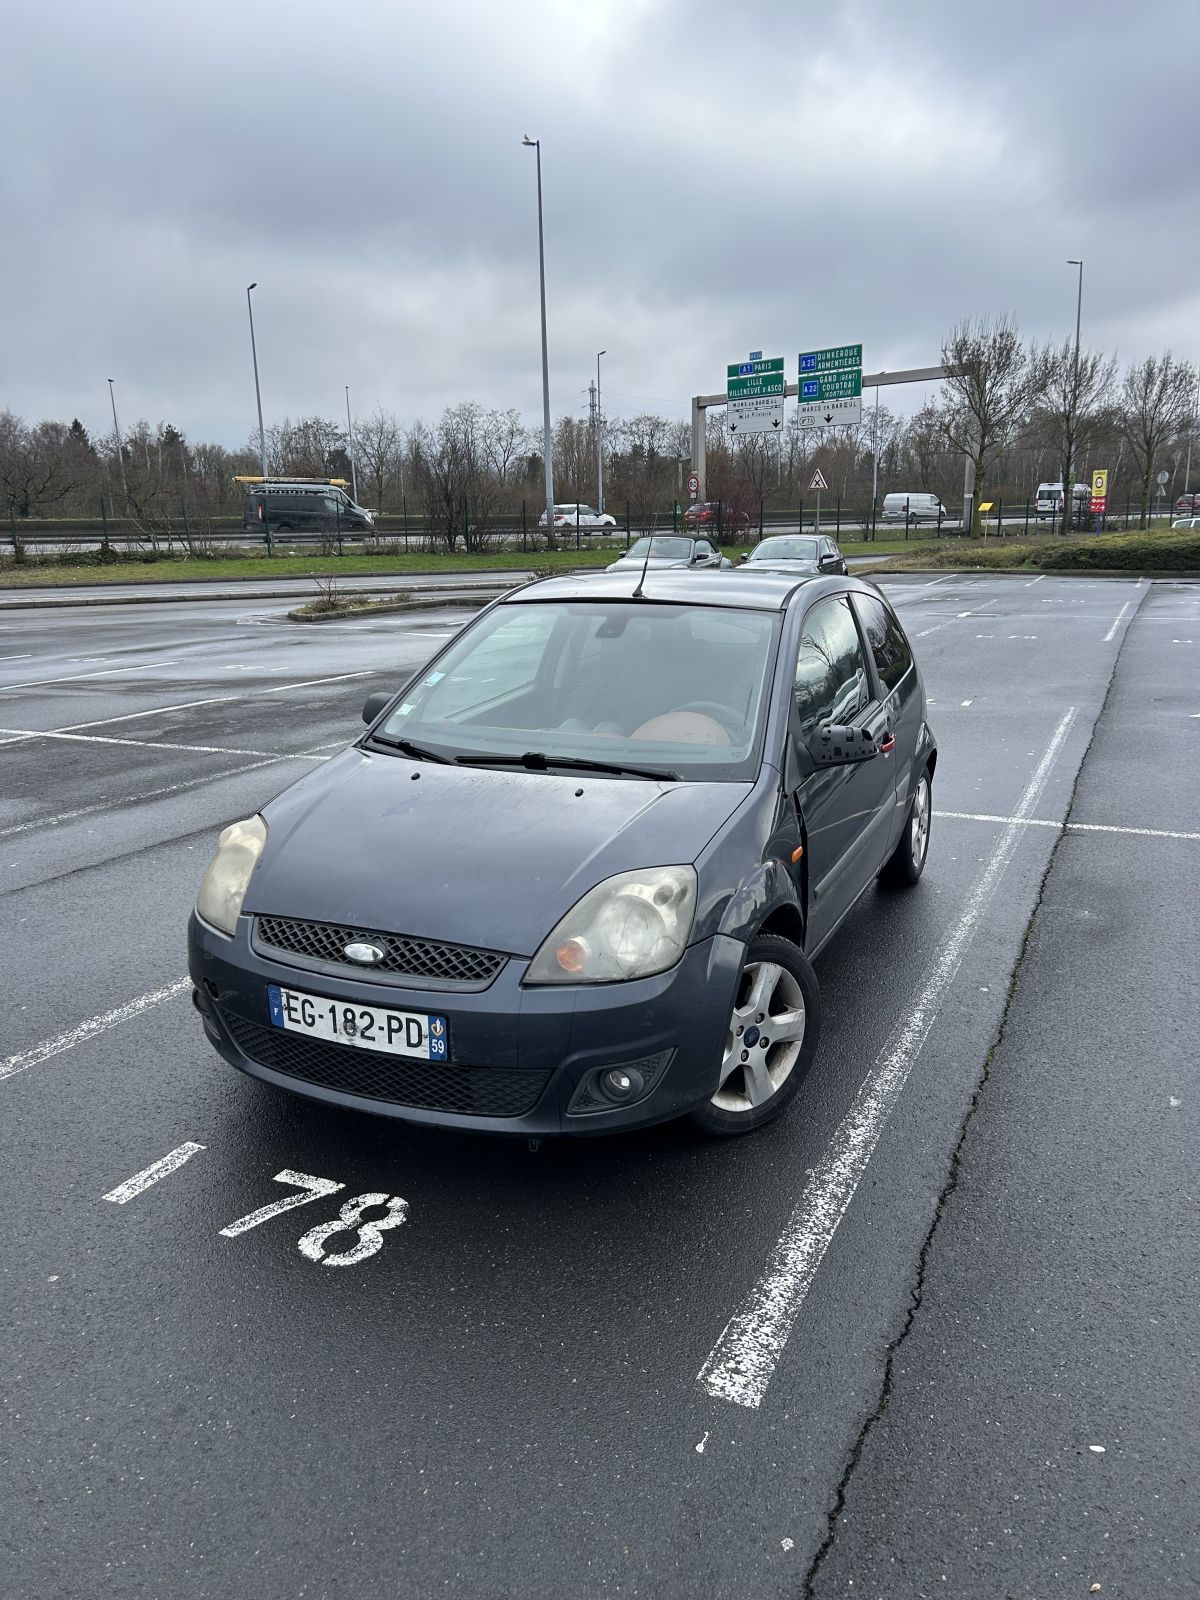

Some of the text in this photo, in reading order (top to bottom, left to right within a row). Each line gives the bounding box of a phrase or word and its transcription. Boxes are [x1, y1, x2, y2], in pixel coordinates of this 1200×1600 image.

[817, 347, 858, 361] DUNKERQUE
[742, 362, 772, 373] A1 PARIS
[802, 359, 815, 368] A25
[747, 377, 763, 386] LILLE
[819, 374, 837, 384] GAND
[729, 386, 761, 397] VILLENEUVE
[804, 384, 817, 393] A22
[822, 381, 855, 392] COURTRAI
[802, 405, 821, 413] MARCQ
[273, 991, 445, 1054] F EG-182-PD 59
[218, 1168, 411, 1266] 78
